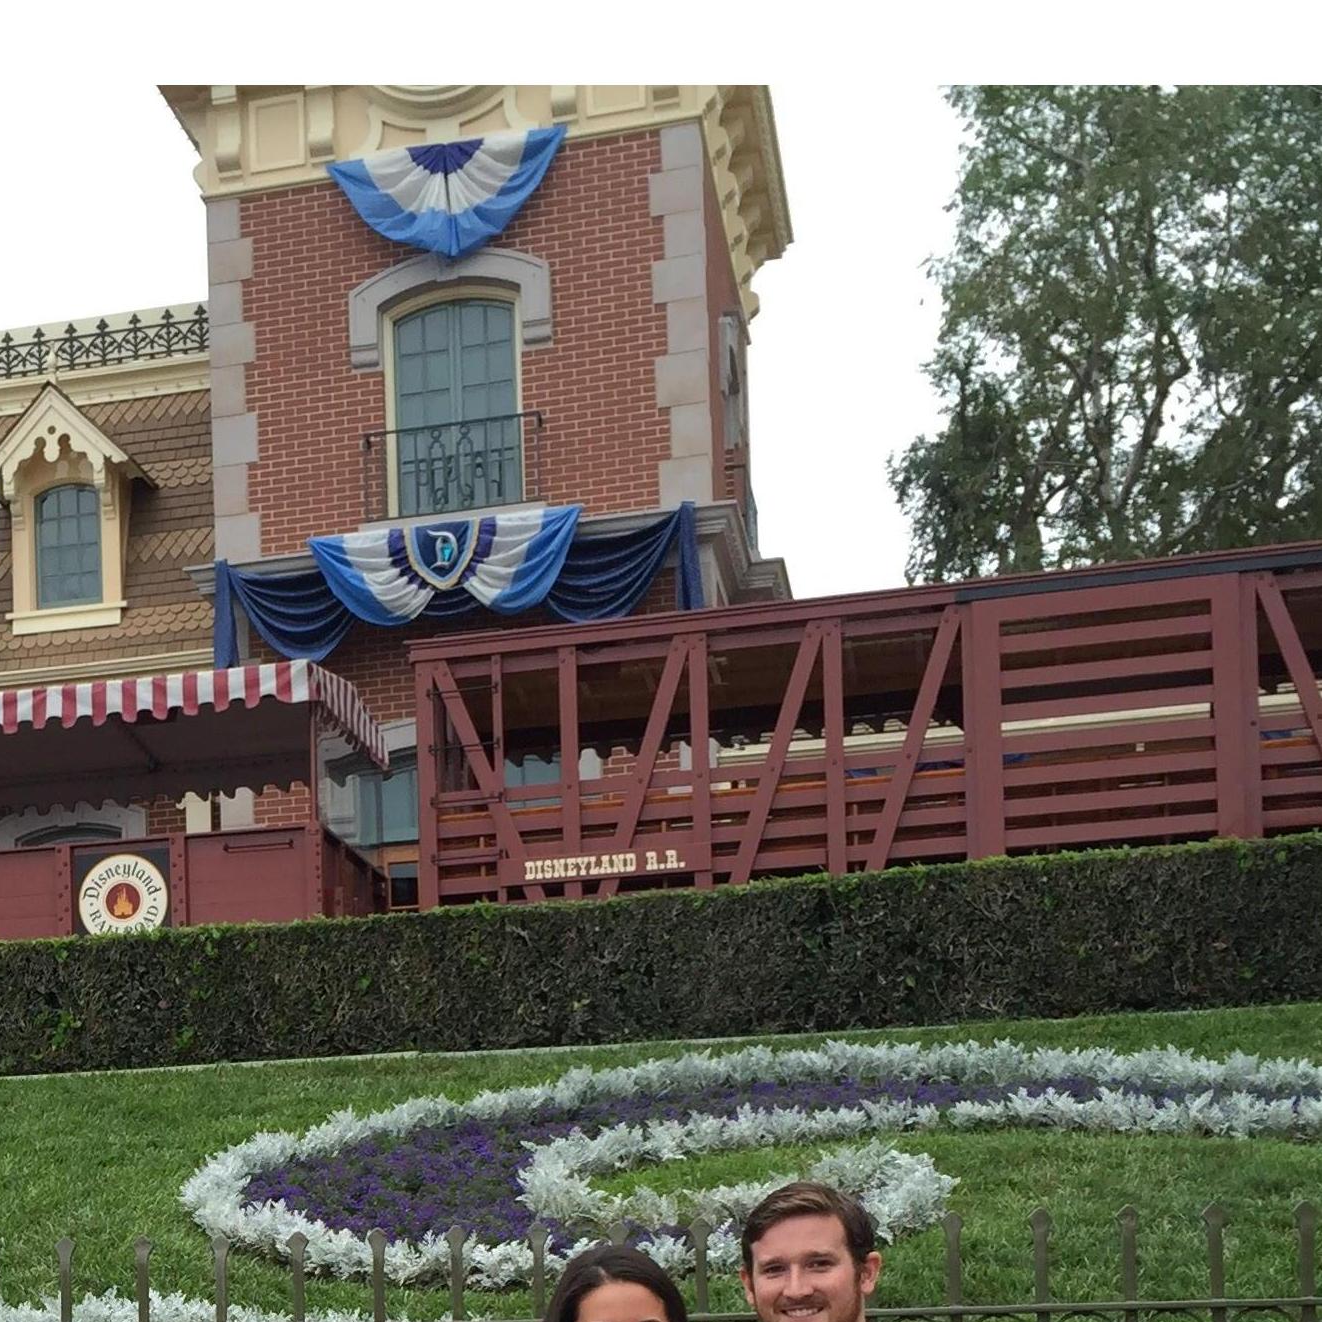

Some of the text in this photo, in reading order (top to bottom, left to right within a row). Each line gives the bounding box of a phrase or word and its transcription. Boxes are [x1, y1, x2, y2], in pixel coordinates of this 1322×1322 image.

[82, 861, 162, 901] Disneyland
[524, 850, 686, 880] DISNEYLAND R.R.
